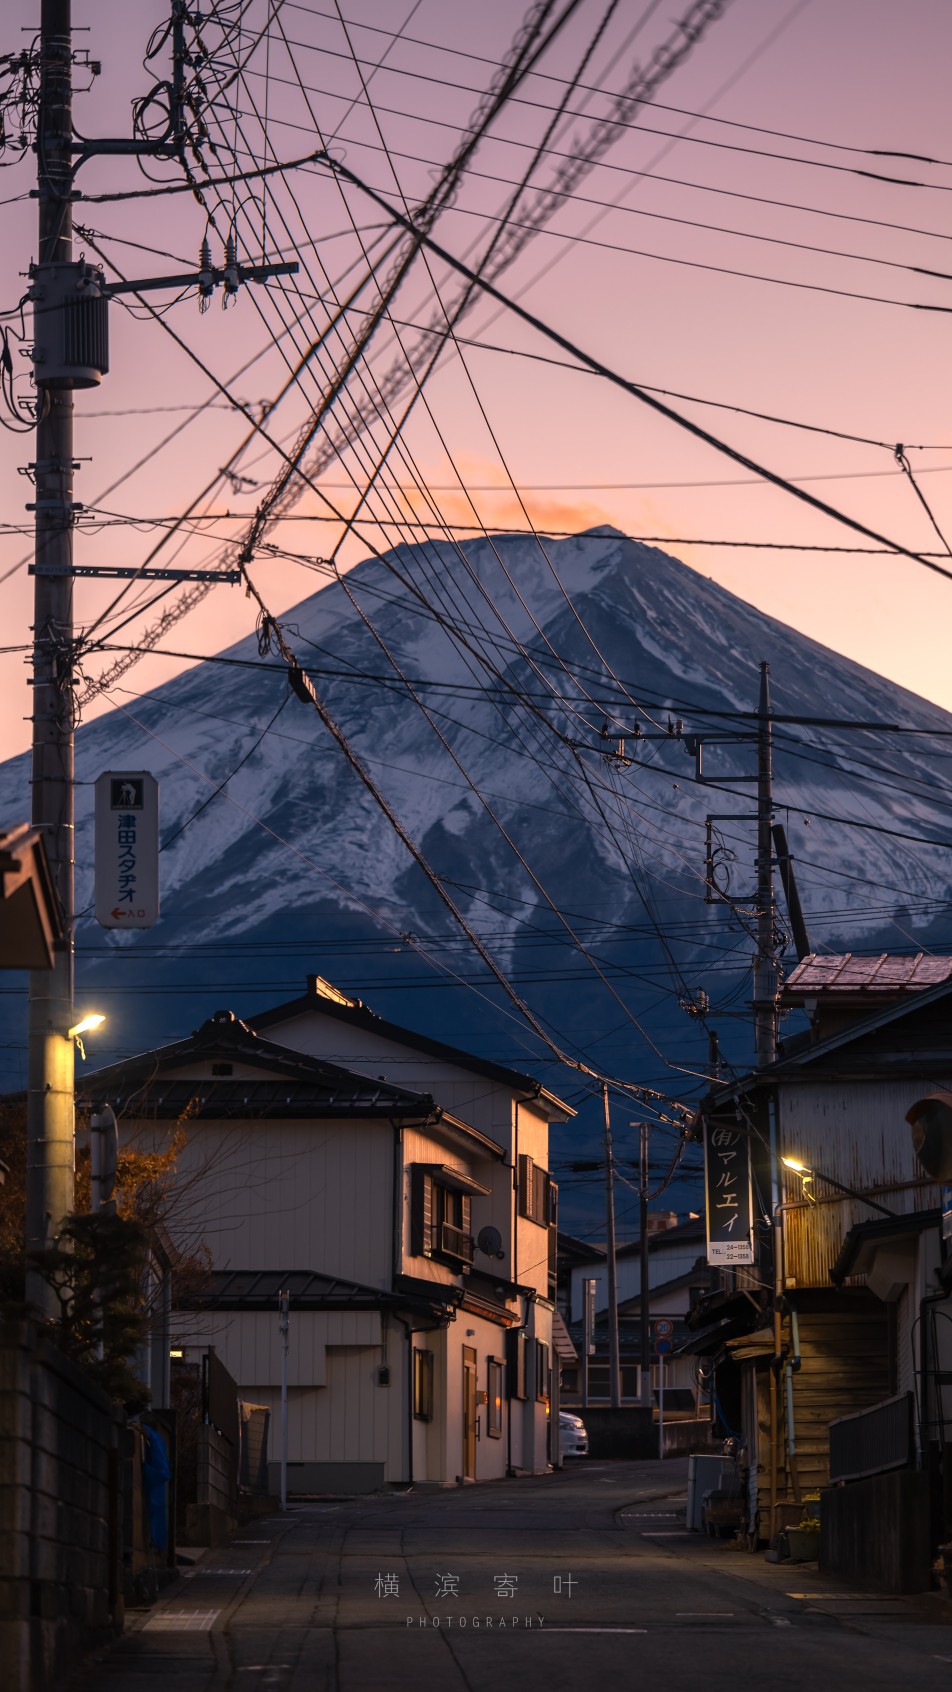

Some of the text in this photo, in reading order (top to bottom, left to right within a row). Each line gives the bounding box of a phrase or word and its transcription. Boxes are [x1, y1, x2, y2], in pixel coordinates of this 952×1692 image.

[117, 814, 136, 903] 津田スタヂオ
[127, 909, 145, 917] 入口
[659, 1323, 669, 1332] 20
